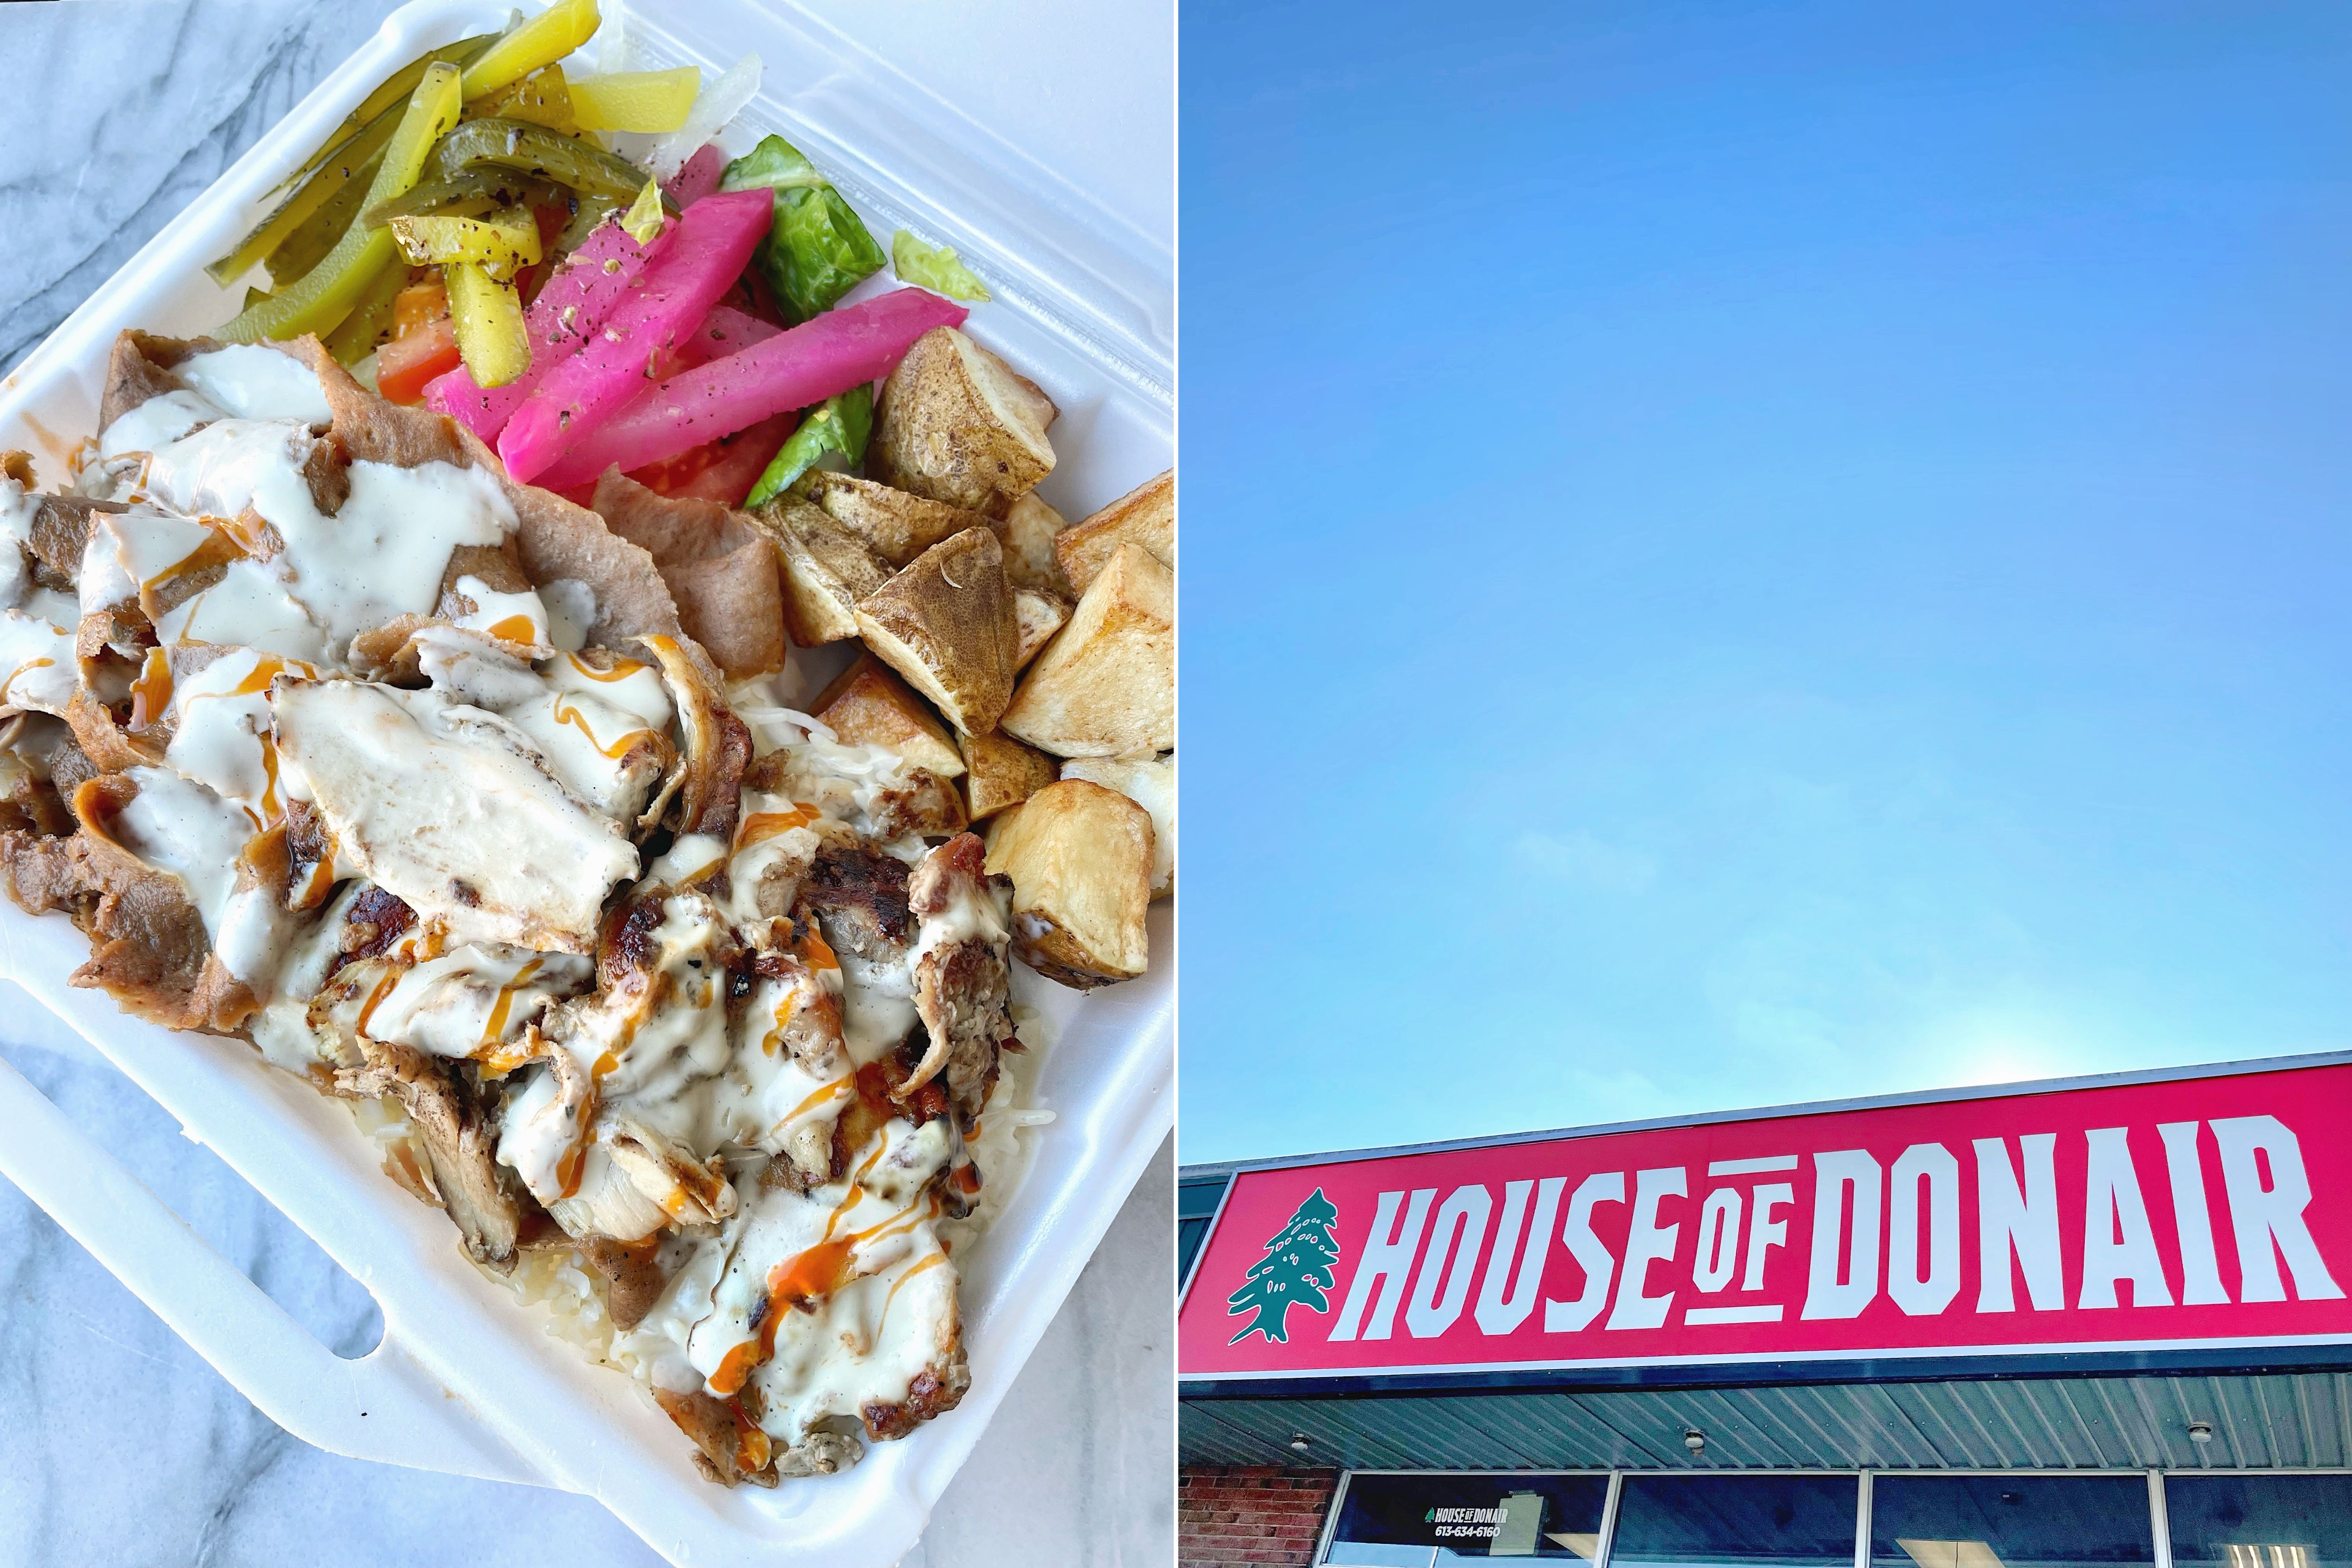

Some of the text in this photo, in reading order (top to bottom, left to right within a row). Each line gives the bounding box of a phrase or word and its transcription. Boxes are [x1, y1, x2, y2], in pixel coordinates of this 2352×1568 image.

[1327, 1115, 2347, 1341] HOUSE OF DONAIR
[1435, 1508, 1508, 1523] HOUSE OF DONAIR
[1435, 1526, 1501, 1537] 613-634-6160
